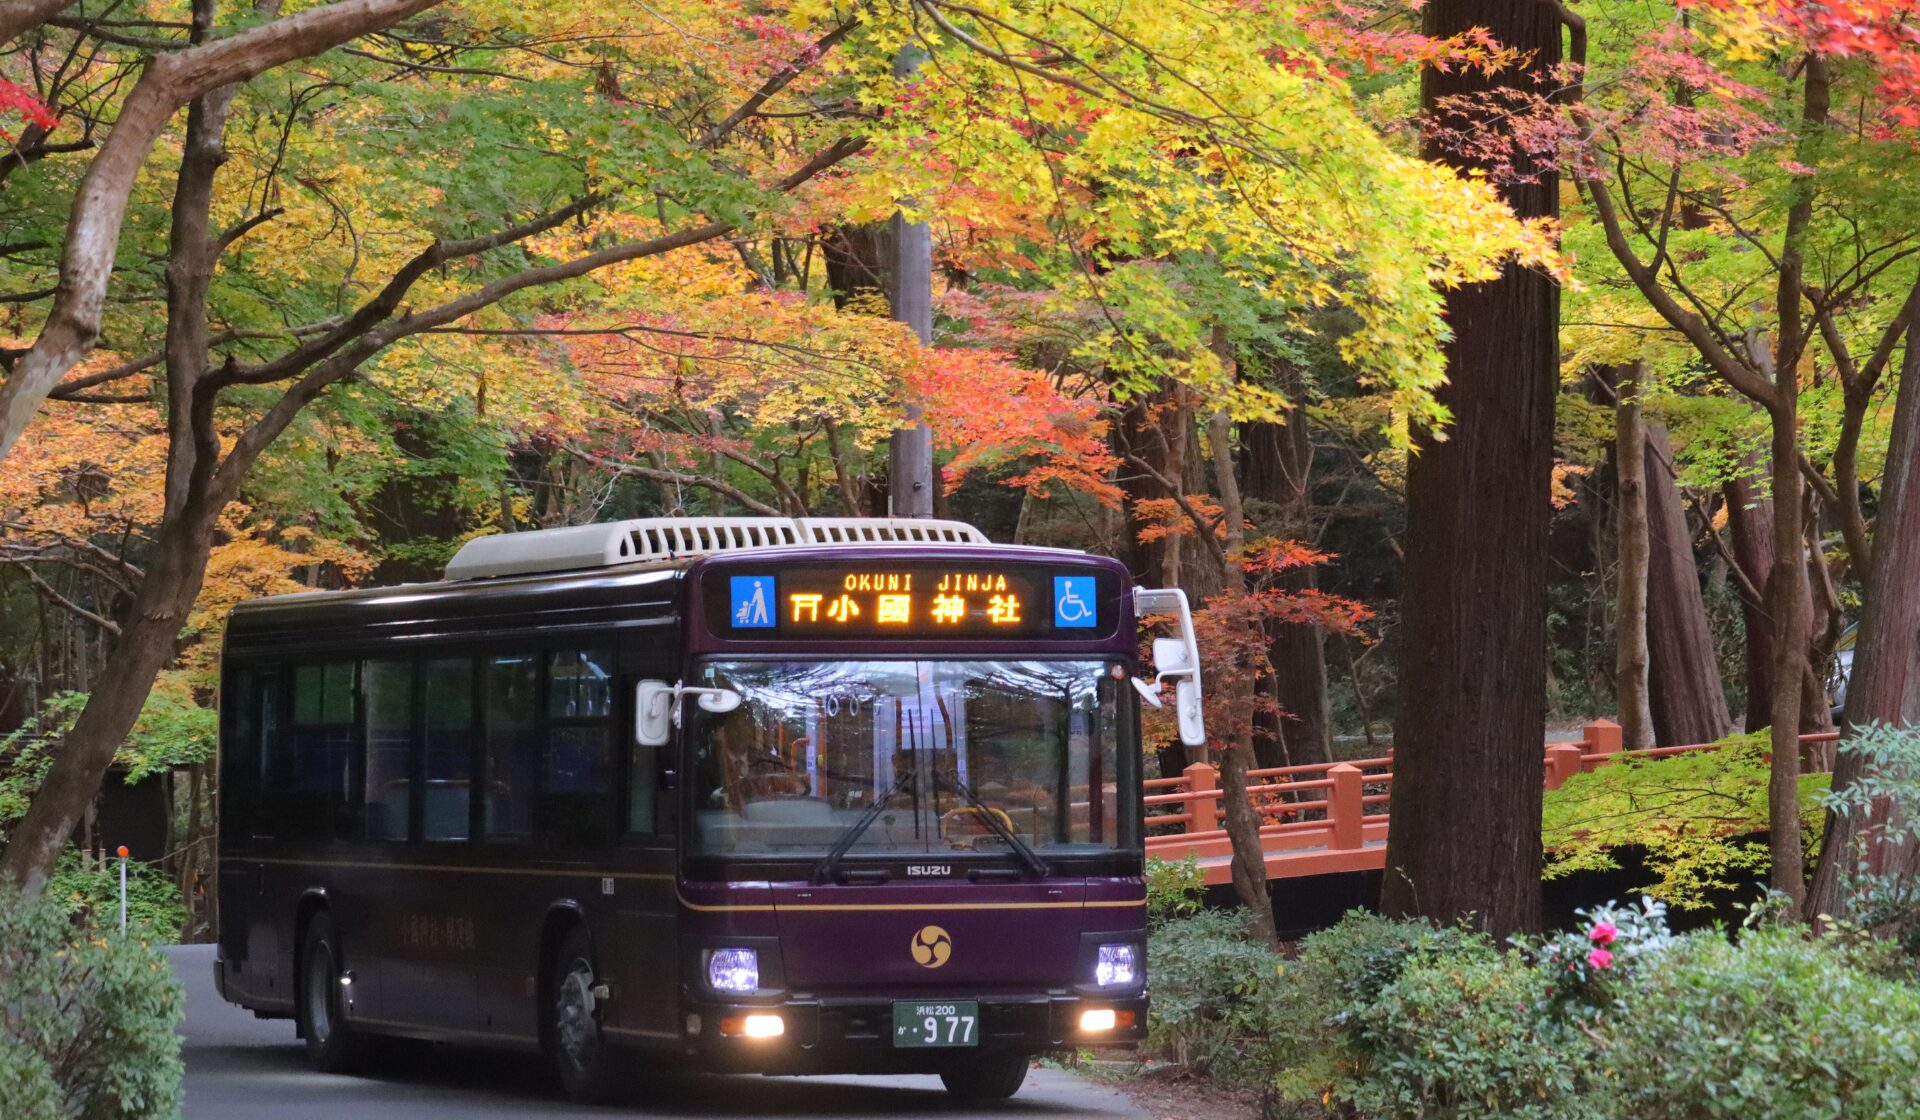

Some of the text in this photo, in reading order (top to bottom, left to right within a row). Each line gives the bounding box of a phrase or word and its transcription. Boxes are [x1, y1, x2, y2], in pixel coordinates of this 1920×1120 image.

[844, 573, 1007, 591] OKUNI JINJA
[827, 593, 1021, 624] 小國神社
[907, 865, 951, 876] ISUZU
